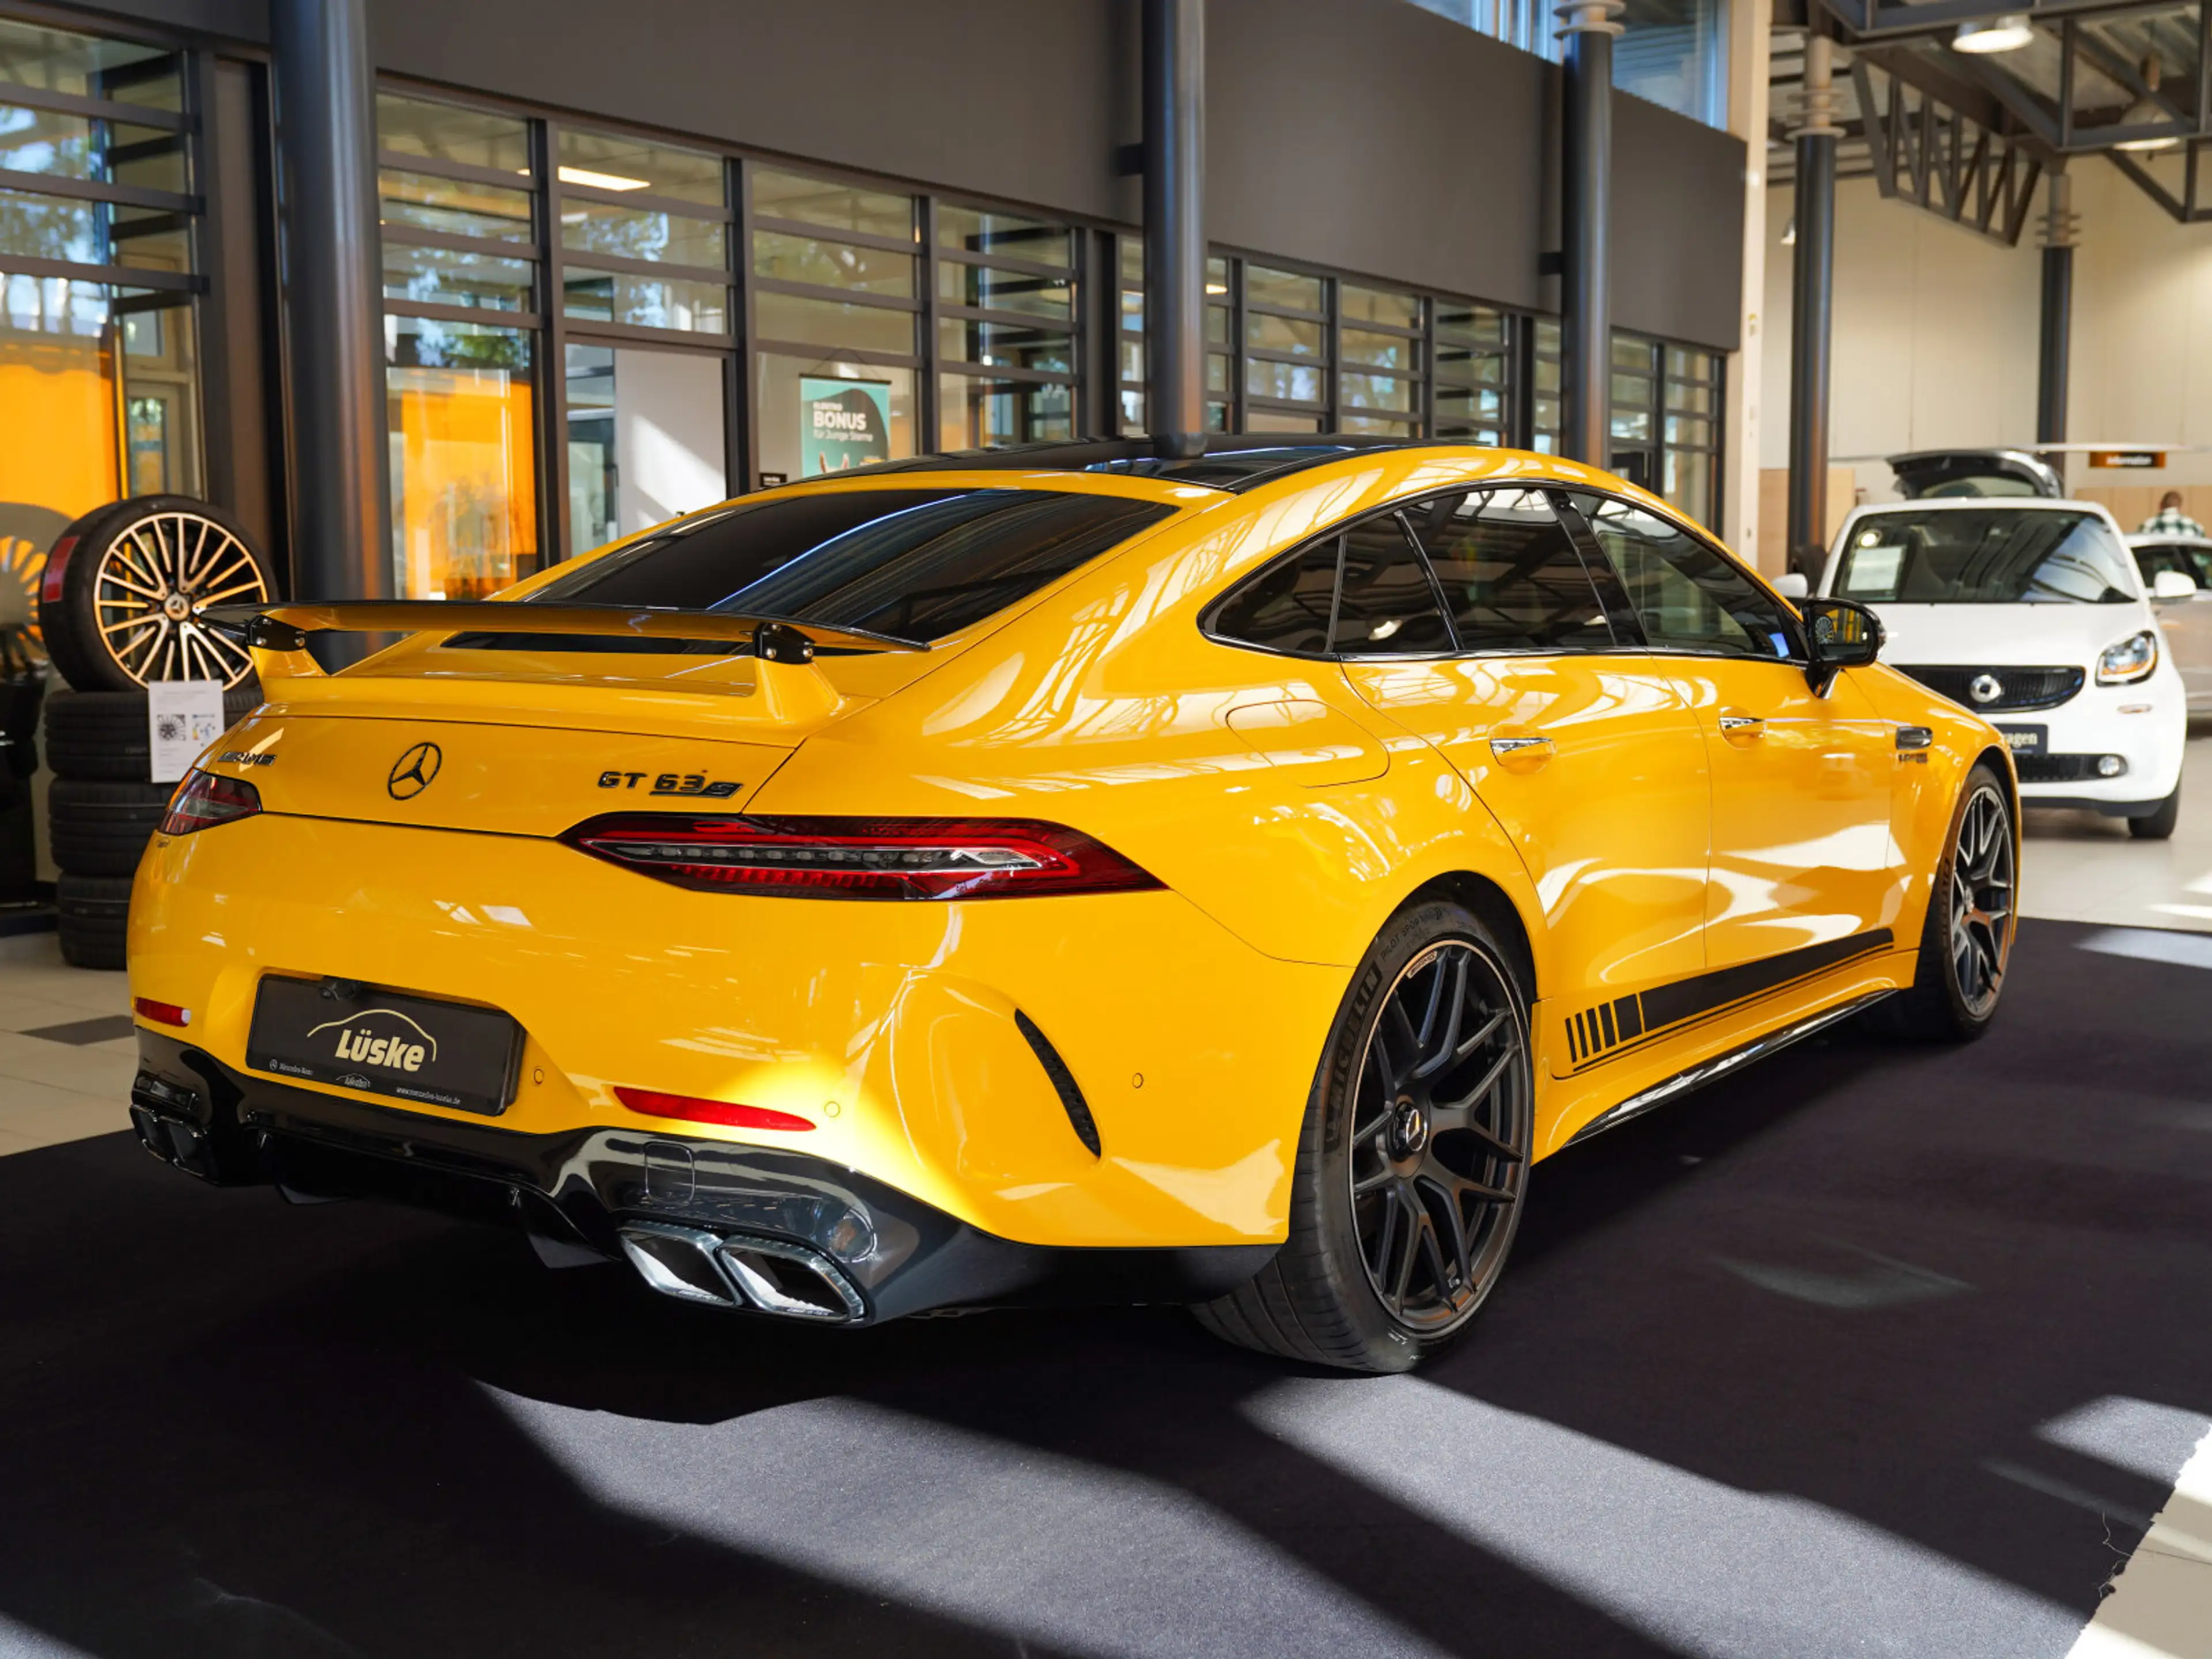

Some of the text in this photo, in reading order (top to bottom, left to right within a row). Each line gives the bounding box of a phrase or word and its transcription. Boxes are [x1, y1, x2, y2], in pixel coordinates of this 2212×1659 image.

[814, 412, 866, 430] BONUS
[597, 771, 647, 789] GT
[654, 774, 706, 791] 63
[335, 1029, 425, 1071] Lüske
